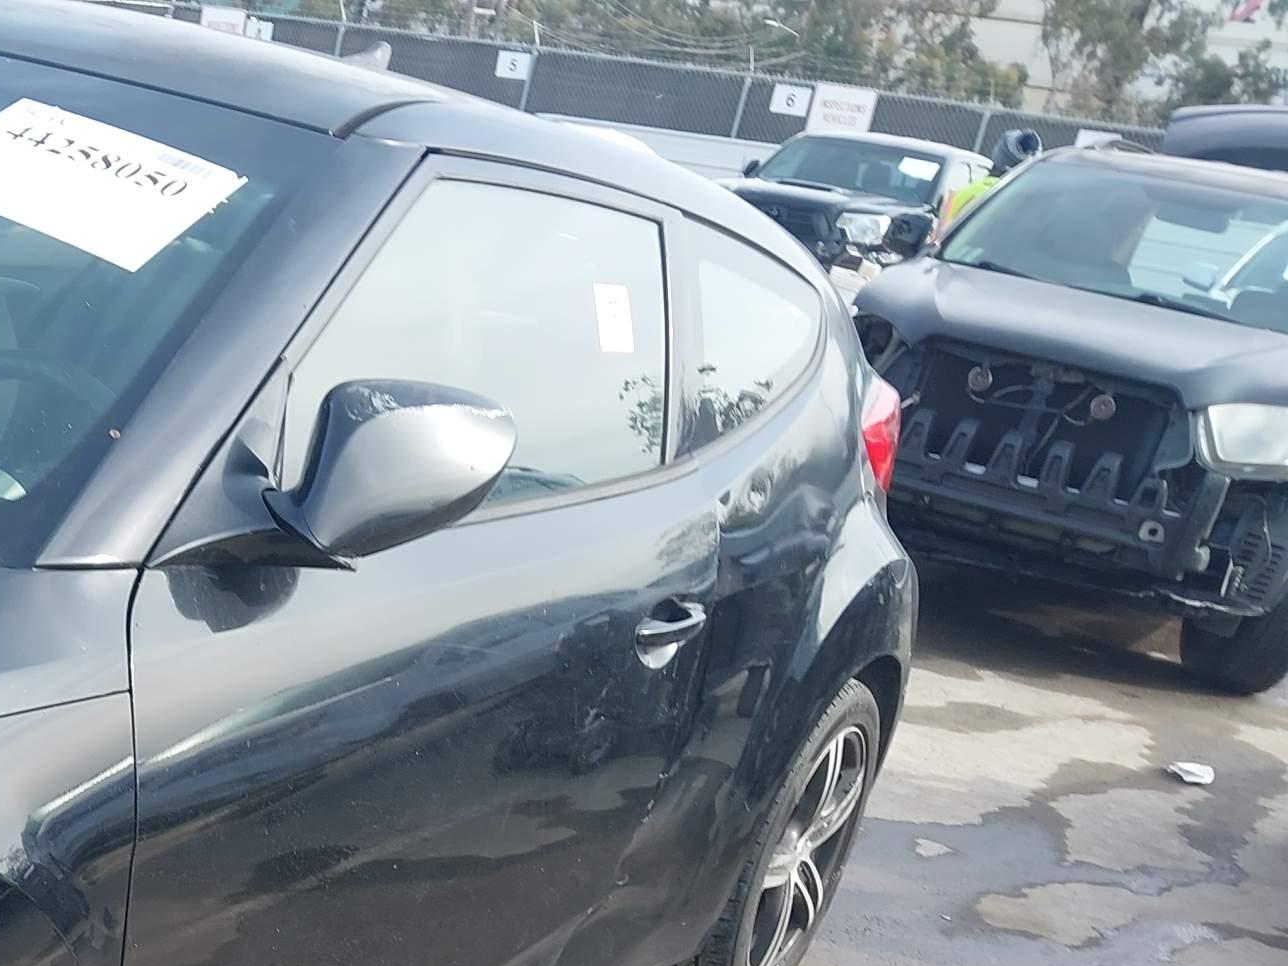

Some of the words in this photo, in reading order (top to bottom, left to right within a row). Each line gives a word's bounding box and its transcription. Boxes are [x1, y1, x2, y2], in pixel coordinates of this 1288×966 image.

[508, 58, 519, 72] 5
[785, 92, 797, 108] 6
[6, 127, 188, 197] 44258050
